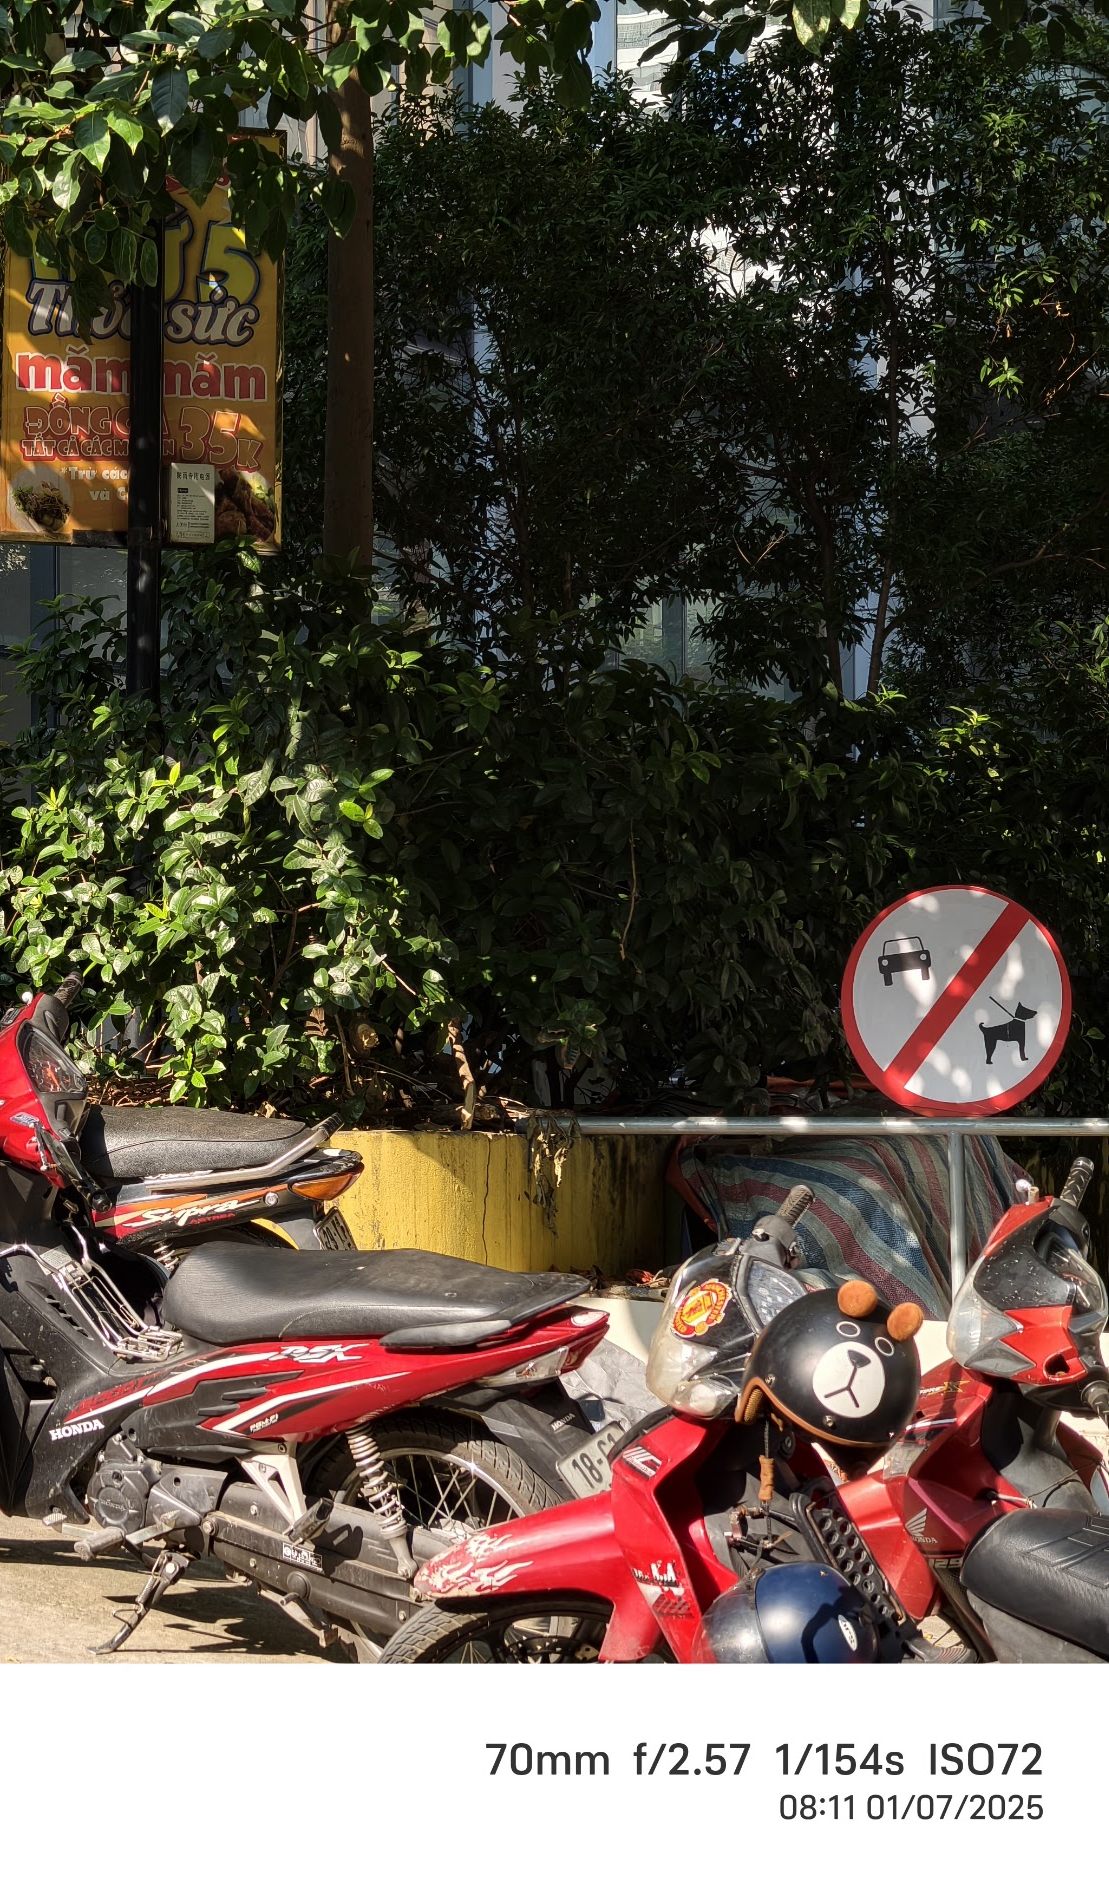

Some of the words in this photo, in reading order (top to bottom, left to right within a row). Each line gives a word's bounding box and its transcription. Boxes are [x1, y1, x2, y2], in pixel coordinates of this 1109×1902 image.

[163, 285, 261, 345] sức
[24, 394, 112, 436] ĐỒNG
[21, 432, 56, 457] TẤT
[80, 434, 112, 457] CÁC
[123, 1199, 261, 1226] Supra
[48, 1418, 105, 1441] HONDA
[551, 1413, 576, 1431] HONDA
